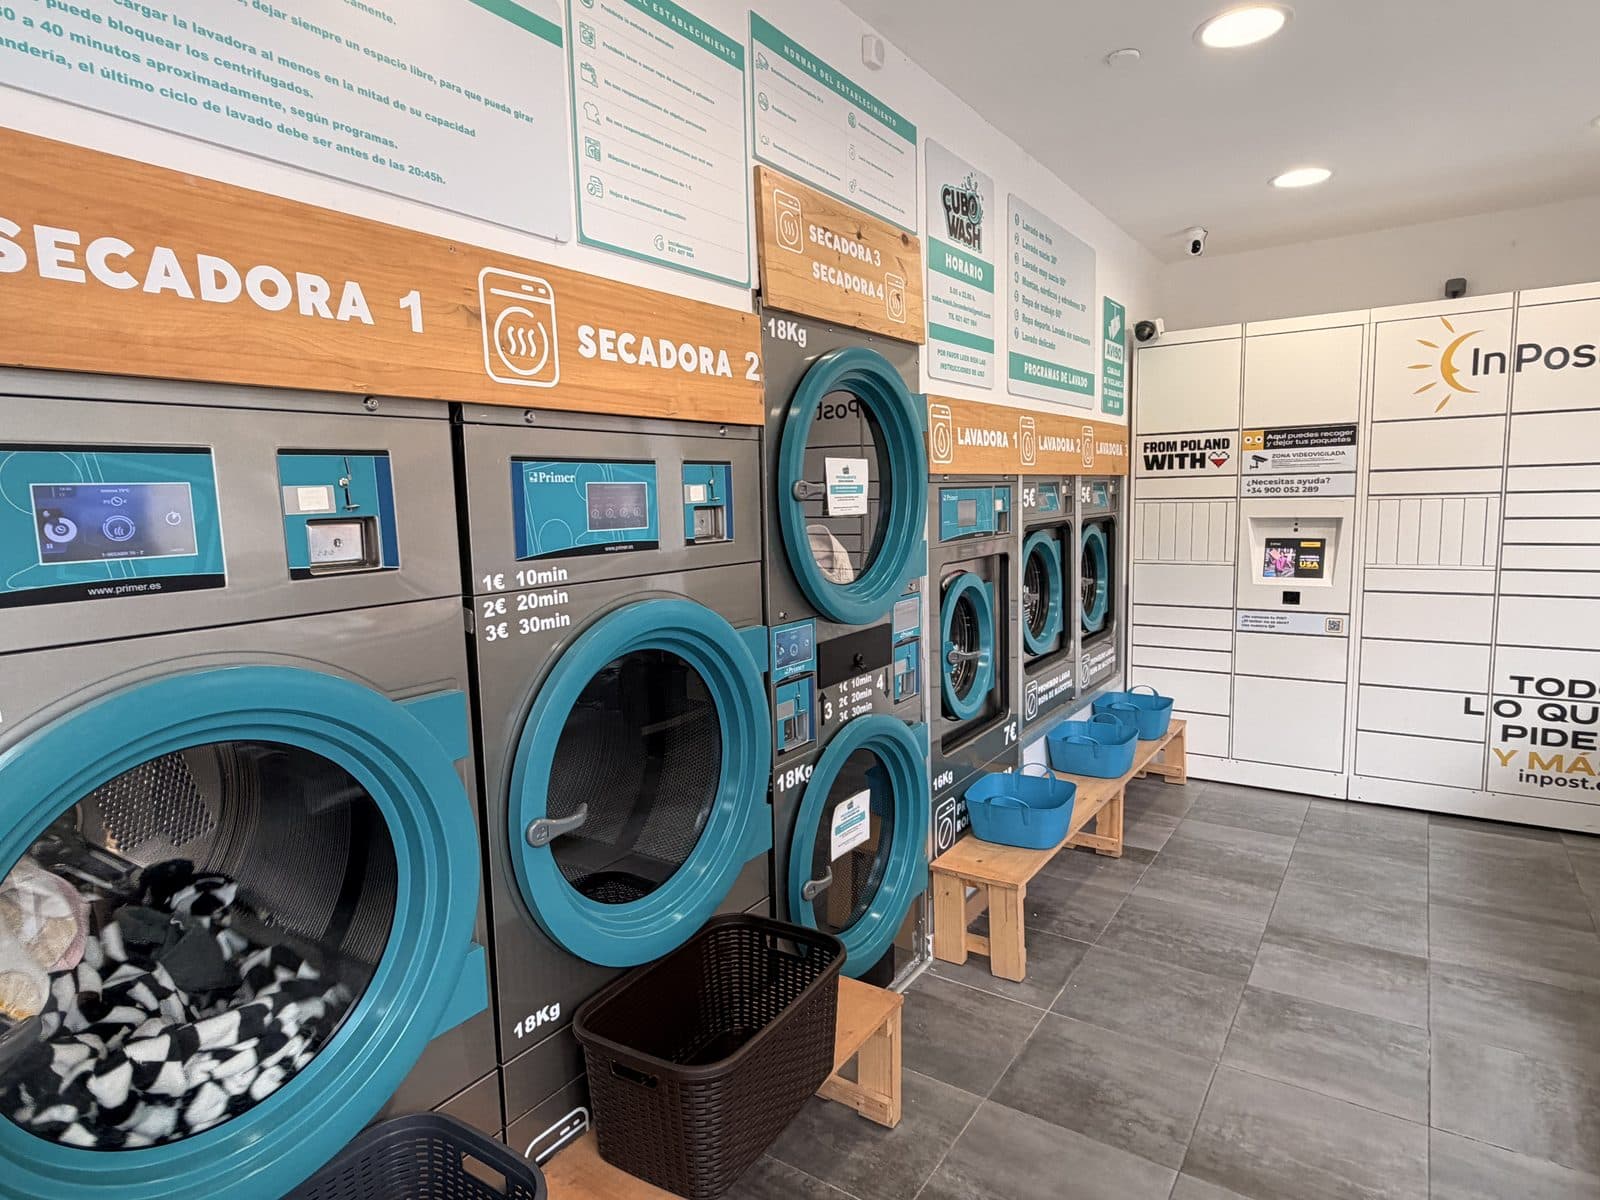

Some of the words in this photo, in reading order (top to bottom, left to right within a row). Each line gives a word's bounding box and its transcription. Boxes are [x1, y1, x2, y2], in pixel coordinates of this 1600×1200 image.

[652, 3, 737, 60] ESTABLECIMIENTO
[46, 0, 102, 24] puede
[107, 16, 182, 52] bloquear
[185, 44, 209, 62] los
[213, 56, 314, 100] centrifugados.
[0, 6, 16, 21] 0
[22, 16, 34, 29] a
[40, 20, 64, 38] 40
[69, 31, 141, 64] minutos
[146, 58, 287, 113] aproximadamente,
[290, 103, 329, 127] según
[332, 121, 398, 150] programas.
[173, 14, 188, 30] la
[192, 22, 257, 56] lavadora
[260, 50, 274, 62] al
[277, 55, 321, 80] menos
[324, 74, 339, 88] en
[342, 77, 354, 93] la
[357, 84, 390, 106] mitad
[392, 97, 407, 112] de
[409, 105, 422, 119] su
[424, 110, 476, 138] capacidad
[291, 14, 342, 44] siempre
[345, 37, 360, 51] un
[363, 45, 407, 71] espacio
[409, 64, 437, 85] libre,
[439, 78, 463, 95] para
[464, 88, 483, 103] que
[484, 97, 512, 116] pueda
[513, 108, 534, 124] girar
[783, 44, 817, 74] NORMAS
[819, 69, 834, 86] DEL
[836, 80, 897, 129] ESTABLECIMIENTO
[78, 61, 95, 75] el
[100, 66, 155, 93] último
[159, 86, 198, 107] ciclo
[202, 99, 221, 114] de
[225, 105, 273, 130] lavado
[276, 122, 309, 142] debe
[312, 134, 333, 149] ser
[335, 141, 370, 161] antes
[372, 151, 386, 166] de
[388, 158, 406, 174] las
[408, 164, 447, 186] 20:45h.
[942, 186, 981, 222] CUBO
[945, 212, 981, 252] WASH
[809, 223, 874, 267] SECADORA
[873, 247, 882, 270] 3
[0, 216, 375, 326] SECADORA
[399, 289, 424, 333] 1
[945, 252, 983, 282] HORARIO
[811, 261, 875, 299] SECADORA
[875, 281, 885, 302] 4
[768, 317, 807, 350] 18Kg
[577, 324, 733, 379] SECADORA
[744, 351, 761, 382] 2
[1471, 342, 1600, 376] InPos
[1024, 361, 1059, 382] PROGRAMAS
[1060, 371, 1067, 384] DE
[1068, 373, 1088, 389] LAVADO
[957, 427, 1009, 449] LAVADORA
[1012, 431, 1018, 448] 1
[1039, 435, 1075, 453] LAVADORA
[1075, 438, 1081, 452] 2
[1096, 440, 1123, 457] LAVADORA
[1143, 441, 1178, 453] FROM
[1180, 437, 1230, 452] POLAND
[1266, 432, 1287, 443] Aquí
[1288, 431, 1319, 442] puedes
[1320, 429, 1354, 440] recoger
[1266, 442, 1272, 450] y
[1272, 438, 1293, 449] dejar
[1295, 438, 1308, 446] tus
[1310, 436, 1351, 447] paquetes
[1143, 453, 1206, 471] WITH
[1292, 450, 1346, 459] VIDEOVIGILADA
[538, 470, 576, 484] Primer
[1246, 477, 1294, 488] ¿Necesitas
[1296, 477, 1331, 488] ayuda?
[1023, 487, 1036, 508] 5€
[1081, 486, 1091, 504] 5€
[482, 573, 504, 592] 1€
[515, 566, 568, 588] 10min
[1299, 561, 1319, 569] USA
[86, 582, 162, 597] www.primer.es
[483, 597, 507, 618] 2€
[516, 589, 569, 611] 20min
[484, 621, 509, 642] 3€
[519, 612, 570, 635] 30min
[838, 681, 849, 694] 1€
[876, 673, 884, 690] 4
[1509, 675, 1600, 699] TOD
[824, 701, 833, 720] 3
[838, 697, 849, 709] 2€
[1464, 697, 1522, 719] LO
[1003, 721, 1017, 746] 7€
[1501, 724, 1598, 751] PIDE
[1493, 748, 1519, 767] Y
[1528, 752, 1600, 777] MÁ
[777, 764, 814, 793] 18Kg
[933, 769, 953, 792] 16Kg
[513, 1002, 561, 1039] 18Kg
